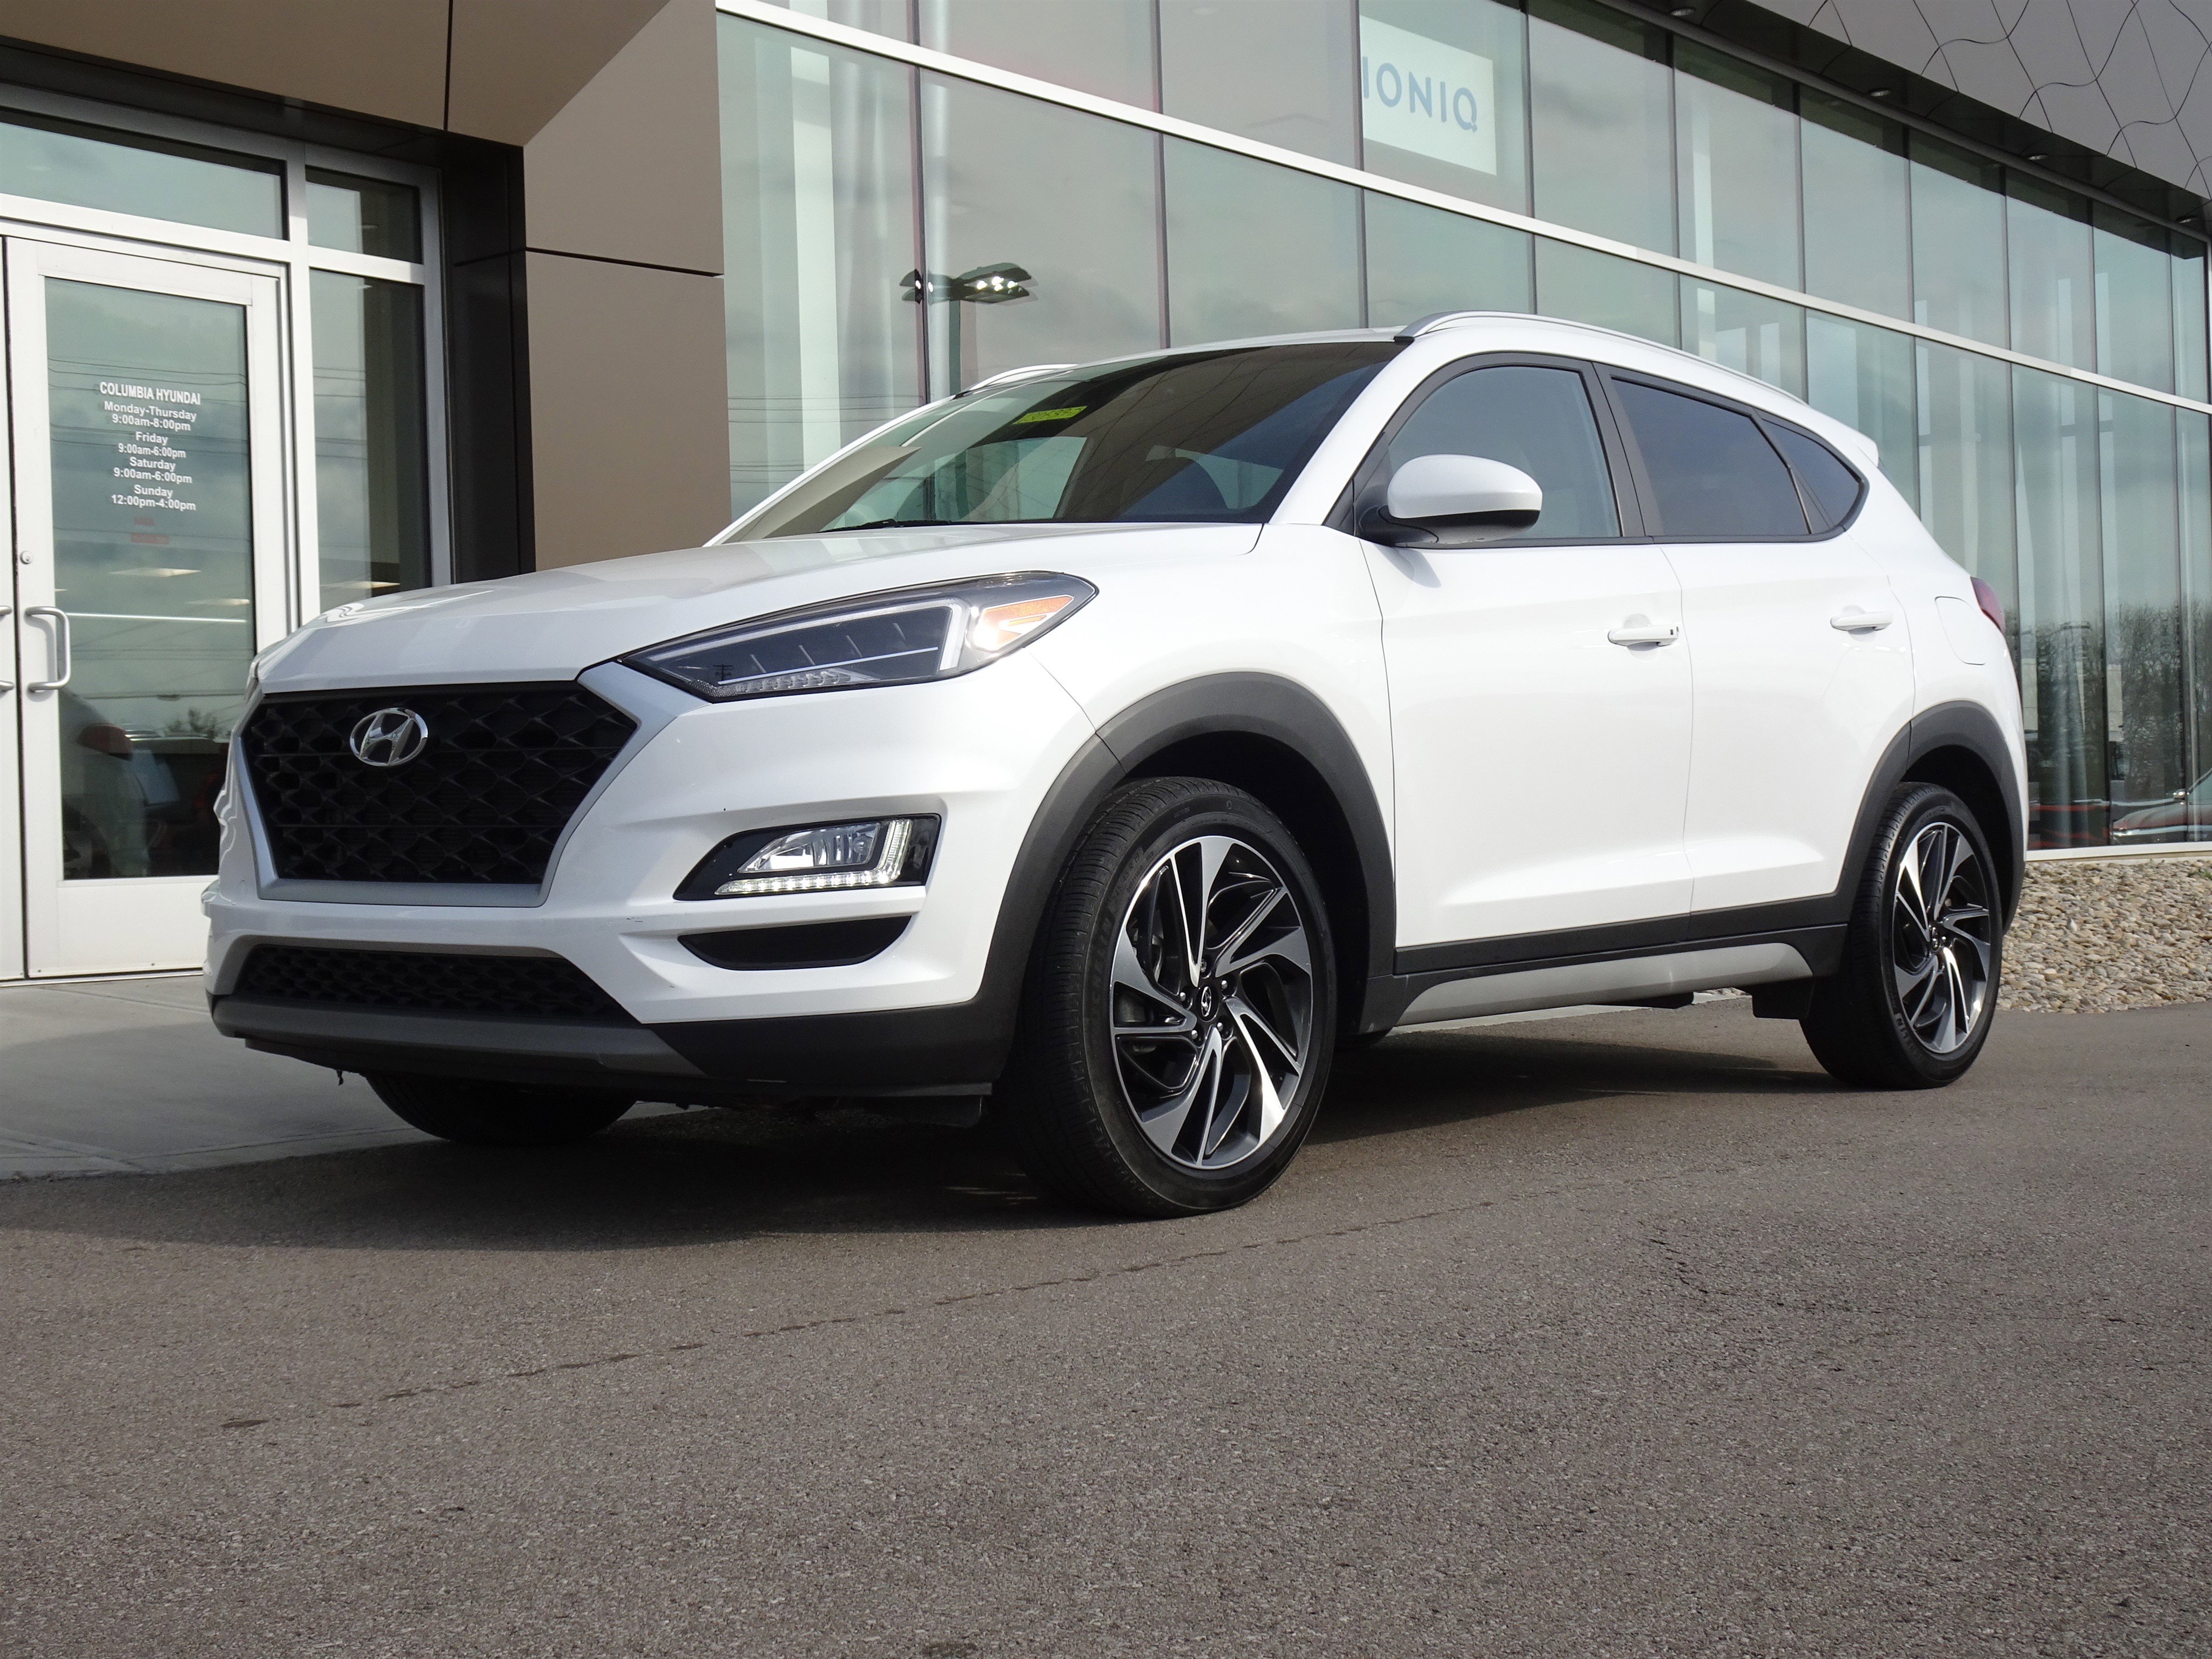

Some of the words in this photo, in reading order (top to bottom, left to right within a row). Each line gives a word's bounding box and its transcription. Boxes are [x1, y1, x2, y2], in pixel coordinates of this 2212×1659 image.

[1362, 56, 1478, 133] IONIQ
[99, 381, 154, 400] COLUMBIA
[156, 388, 201, 406] HYUNDAI
[104, 401, 197, 423] Monday-Thursday
[112, 413, 191, 432] 9:00am-8:00pm
[136, 431, 168, 446] Friday
[118, 443, 187, 460] 9:00am-6:00pm
[130, 456, 176, 473] Saturday
[113, 467, 193, 485] 9:00am-6:00pm
[134, 484, 173, 500] Sunday
[111, 494, 197, 512] 12:00pm-4:00pm
